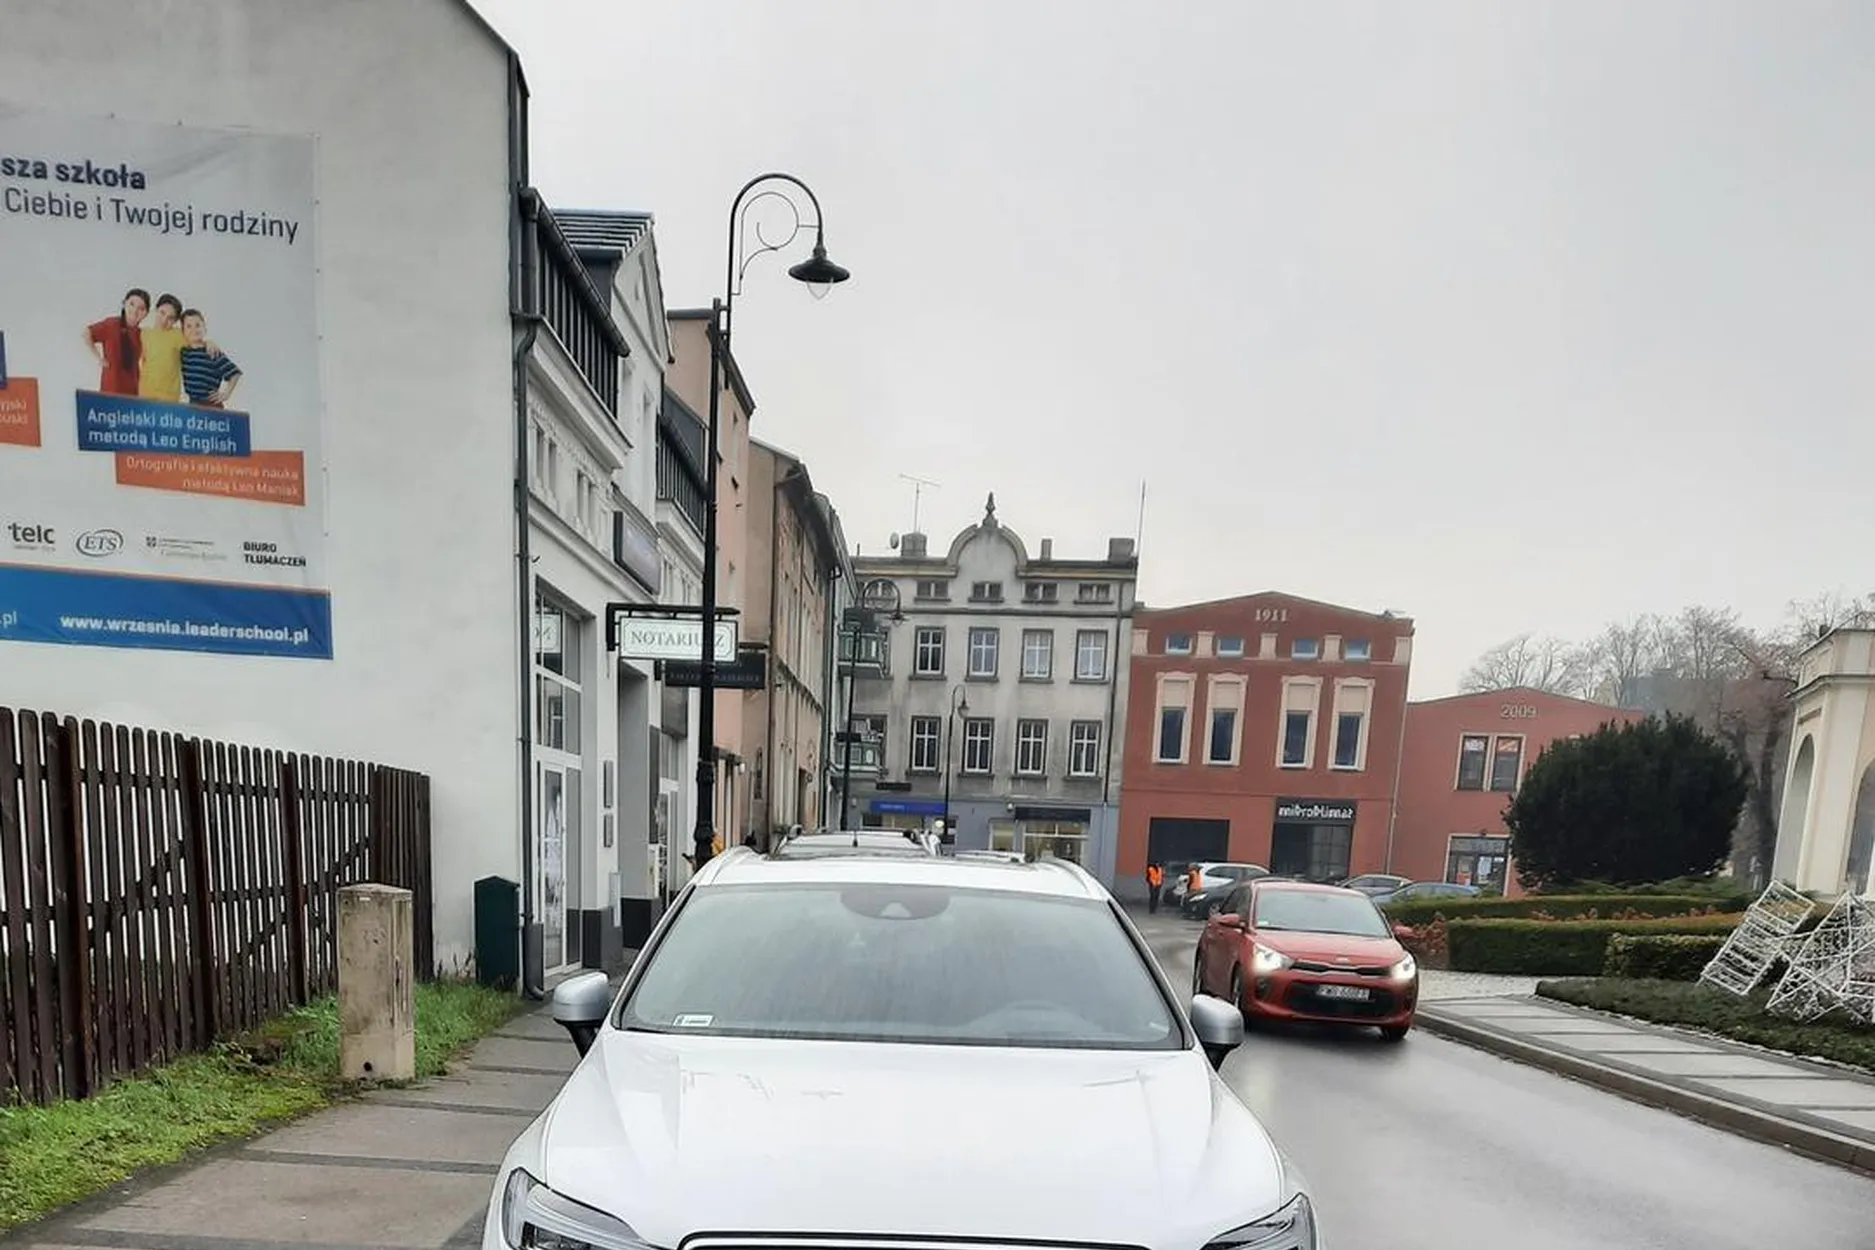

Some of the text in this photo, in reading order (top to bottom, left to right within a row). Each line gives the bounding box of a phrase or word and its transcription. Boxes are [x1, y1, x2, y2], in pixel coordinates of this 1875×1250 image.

[0, 156, 146, 190] sza szkoła
[5, 187, 299, 245] Ciebie i Twojej rodziny
[88, 407, 230, 434] Angielski dla dzieci
[89, 428, 238, 454] metodą Leo English
[126, 455, 190, 474] Ortografia
[262, 466, 299, 480] nauka
[11, 522, 56, 545] telc
[84, 536, 118, 551] ETS
[243, 541, 277, 554] BIURO
[1255, 607, 1289, 623] 1911
[60, 613, 310, 646] www.wrzesnia.leaderschool.pl
[630, 629, 726, 649] NOTARIUZ
[1500, 704, 1538, 719] 2009
